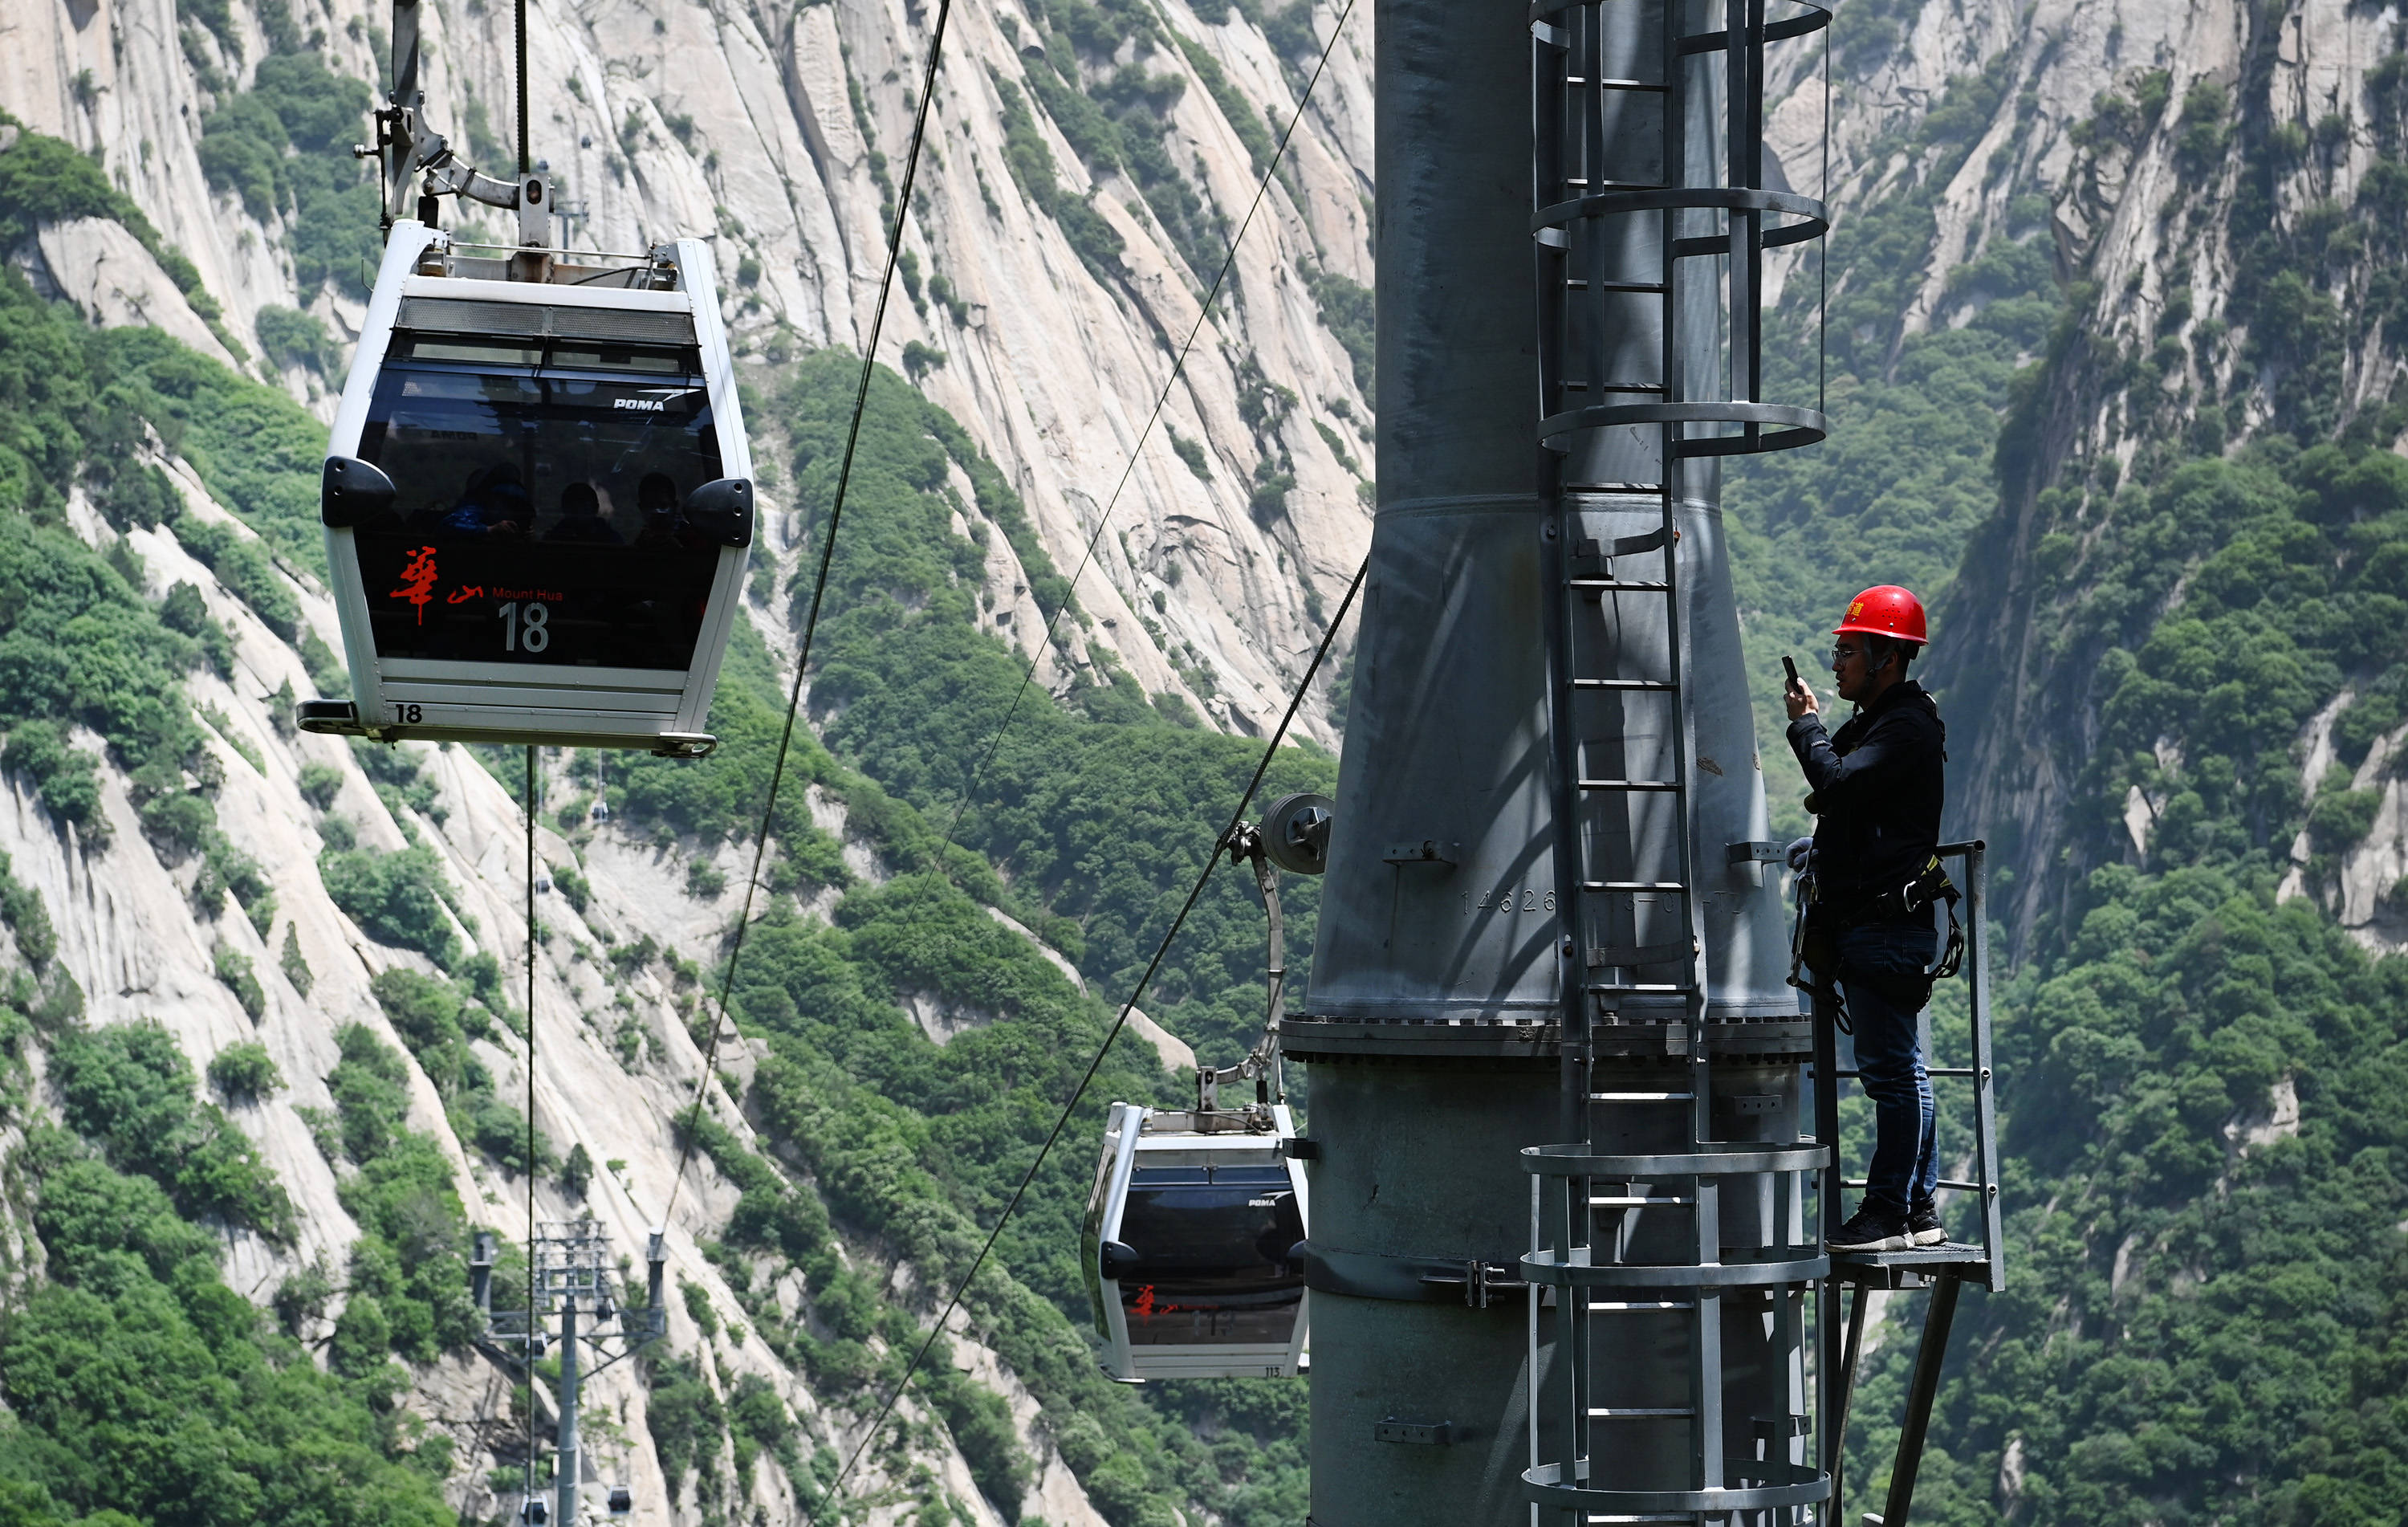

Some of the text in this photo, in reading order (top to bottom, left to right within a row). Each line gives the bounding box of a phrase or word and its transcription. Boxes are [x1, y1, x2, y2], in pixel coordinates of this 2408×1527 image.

[613, 398, 665, 411] POMA
[492, 587, 564, 602] Mount Hua
[498, 601, 550, 654] 18
[395, 703, 423, 724] 18
[1248, 1199, 1276, 1207] POMA
[1265, 1366, 1281, 1378] 113
